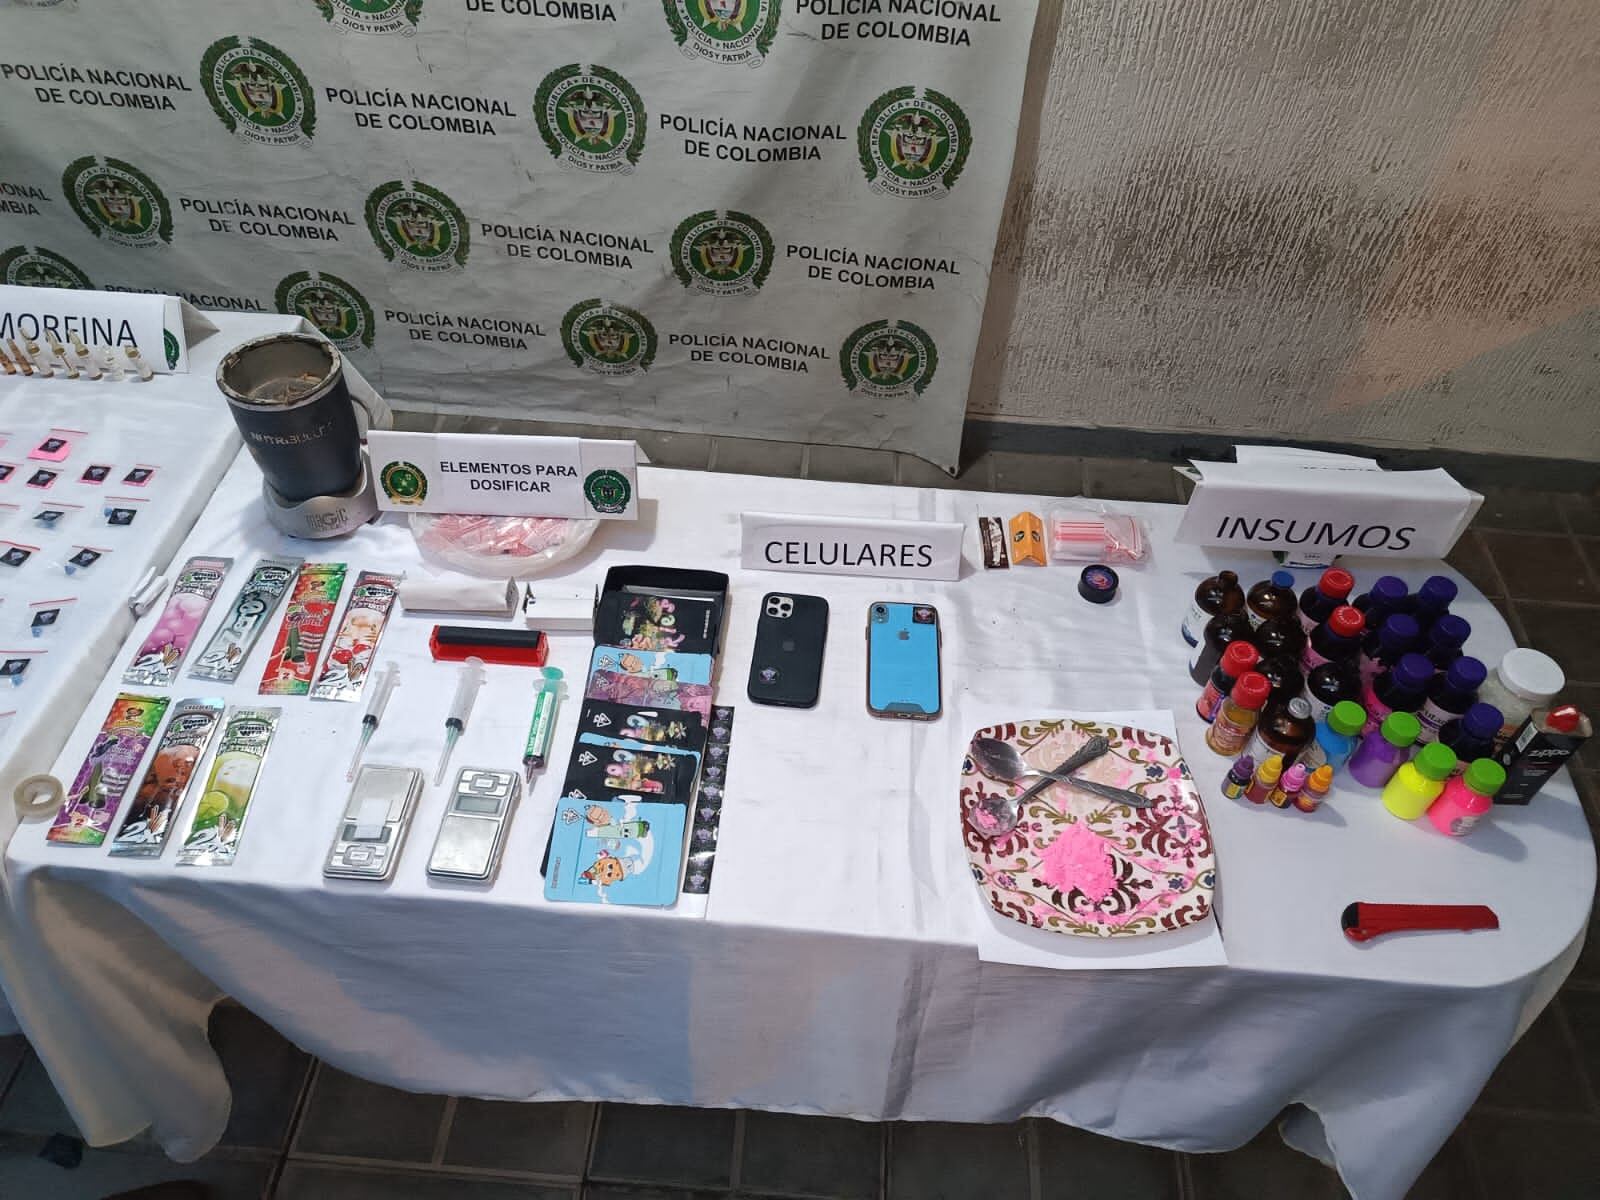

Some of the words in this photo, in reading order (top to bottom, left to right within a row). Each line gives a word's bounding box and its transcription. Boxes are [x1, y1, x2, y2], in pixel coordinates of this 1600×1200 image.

[466, 0, 495, 12] DE
[501, 0, 617, 22] COLOMBIA
[889, 0, 1001, 22] NACIONAL
[374, 21, 403, 32] PATRIA
[683, 15, 712, 46] POLICIA
[723, 24, 762, 49] NACIONAL
[822, 22, 850, 40] DE
[857, 21, 970, 46] COLOMBIA
[693, 43, 713, 58] DIOS
[722, 50, 752, 61] PATRIA
[1, 63, 82, 83] POLICÍA
[89, 70, 192, 91] NACIONAL
[35, 88, 64, 104] DE
[70, 90, 176, 111] COLOMBIA
[326, 88, 406, 108] POLICÍA
[411, 93, 516, 116] NACIONAL
[355, 112, 383, 128] DE
[388, 114, 496, 136] COLOMBIA
[660, 114, 738, 140] POLICÍA
[743, 125, 846, 142] NACIONAL
[872, 102, 904, 145] REPUBLICA
[935, 109, 957, 153] COLOMBIA
[684, 140, 710, 158] DE
[716, 141, 822, 162] COLOMBIA
[876, 156, 901, 182] POLICIA
[910, 163, 950, 186] NACIONAL
[881, 180, 901, 194] DIOS
[908, 185, 937, 196] PATRIA
[180, 198, 252, 218] POLICÍA
[258, 204, 356, 225] NACIONAL
[209, 219, 233, 233] DE
[240, 221, 338, 242] COLOMBIA
[482, 224, 554, 242] POLICÍA
[559, 230, 654, 252] NACIONAL
[507, 244, 530, 258] DE
[537, 248, 632, 268] COLOMBIA
[787, 245, 859, 266] POLICÍA
[864, 254, 960, 274] NACIONAL
[808, 266, 832, 280] DE
[838, 268, 935, 290] COLOMBIA
[384, 310, 452, 328] POLICÍA
[457, 316, 546, 336] NACIONAL
[408, 328, 432, 341] DE
[438, 331, 528, 350] COLOMBIA
[669, 333, 738, 348] POLICÍA
[743, 337, 831, 360] NACIONAL
[690, 350, 714, 362] DE
[720, 351, 808, 373] COLOMBIA
[440, 461, 531, 476] ELEMENTOS
[536, 464, 578, 478] PARA
[470, 479, 550, 493] DOSIFICAR
[1215, 516, 1416, 550] INSUMOS
[764, 541, 933, 568] CELULARES
